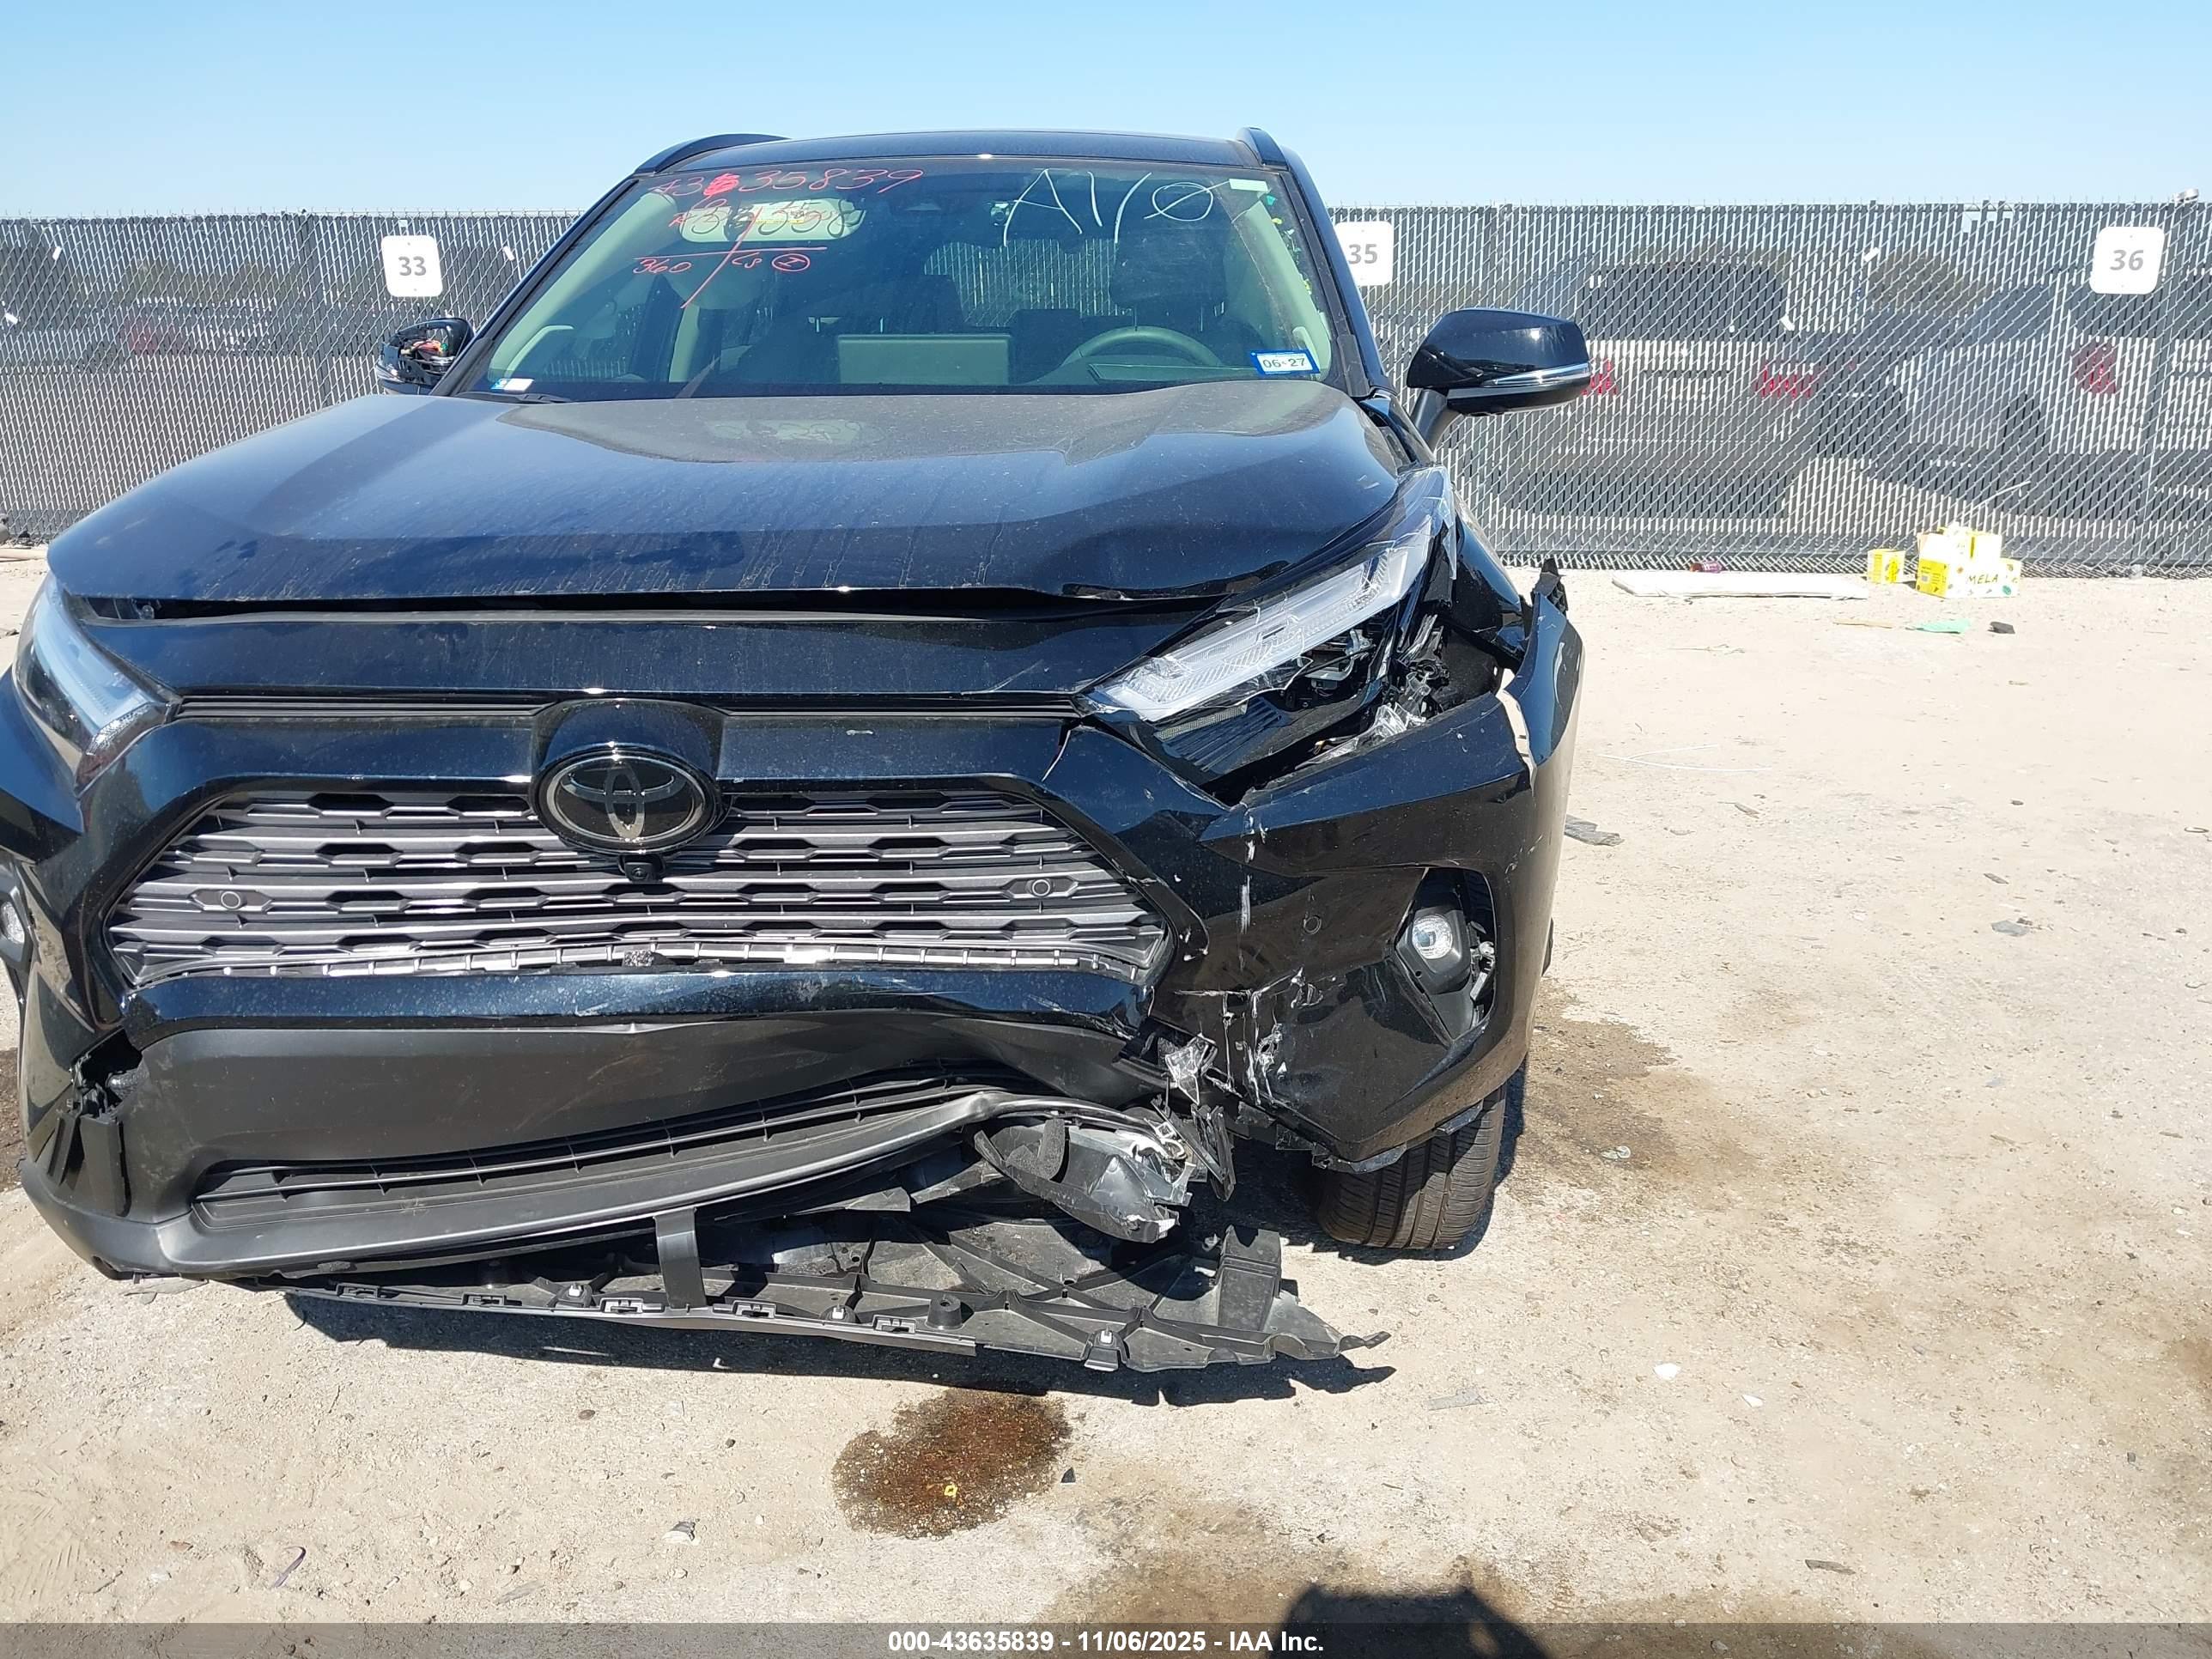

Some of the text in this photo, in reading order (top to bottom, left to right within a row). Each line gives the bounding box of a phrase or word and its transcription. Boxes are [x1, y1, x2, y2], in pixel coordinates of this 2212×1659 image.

[1347, 243, 1378, 264] 35
[2109, 249, 2144, 271] 36
[398, 256, 427, 276] 33
